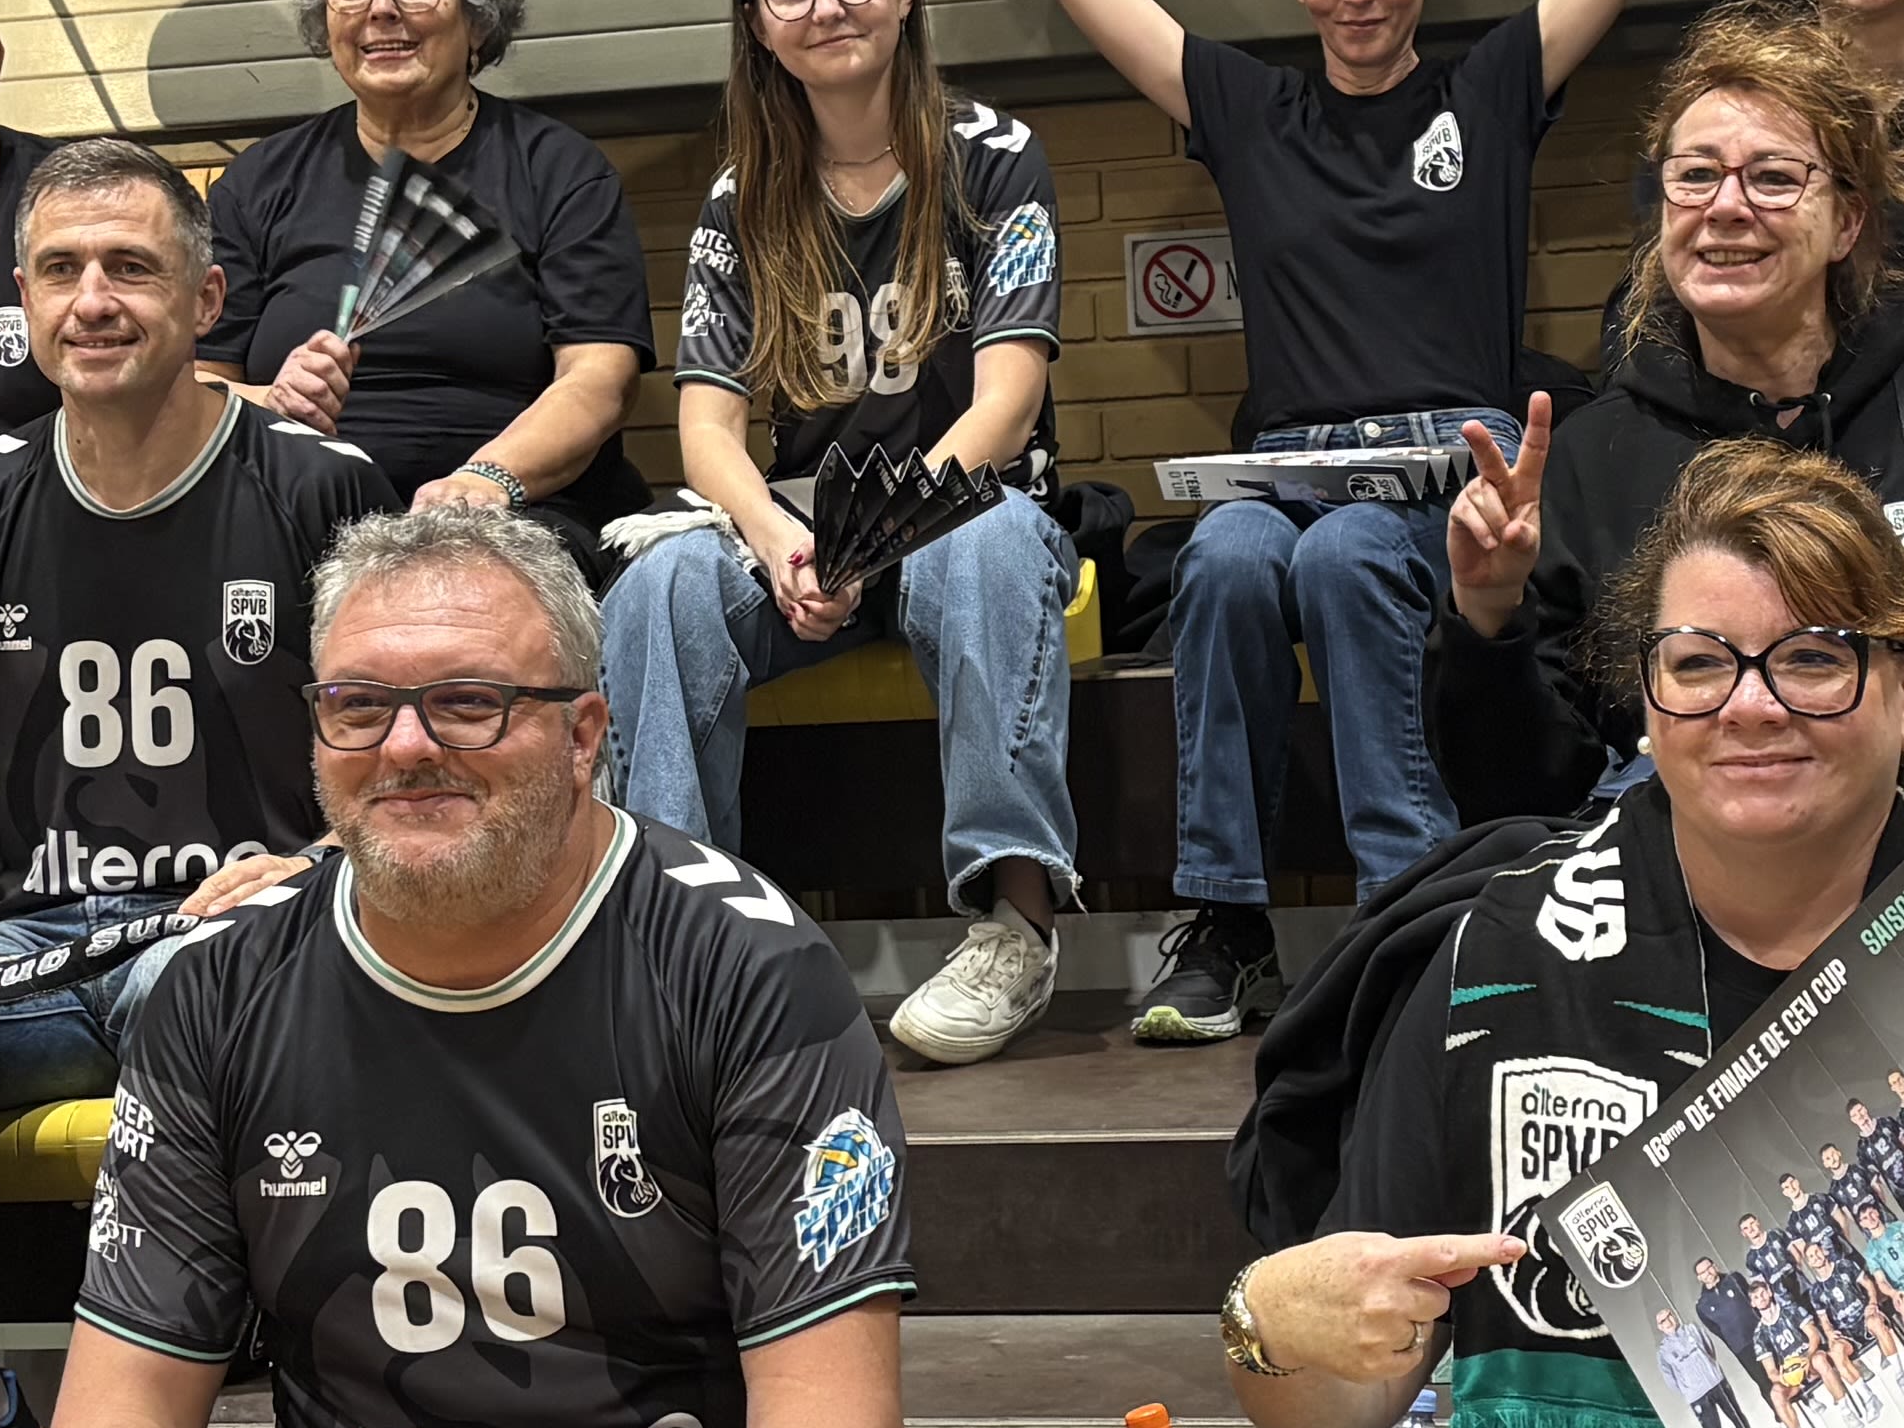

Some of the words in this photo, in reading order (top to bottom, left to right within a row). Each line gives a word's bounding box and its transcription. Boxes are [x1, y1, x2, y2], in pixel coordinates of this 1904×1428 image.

[231, 598, 267, 615] SPVB
[58, 638, 196, 769] 86
[1684, 1096, 1715, 1132] DE
[1706, 1048, 1769, 1111] FINALE
[1759, 1024, 1791, 1058] DE
[1781, 990, 1819, 1037] CEV
[1810, 958, 1848, 997] CUP
[259, 1176, 327, 1197] hummel
[1577, 1204, 1619, 1242] SPVB
[366, 1178, 567, 1354] 86
